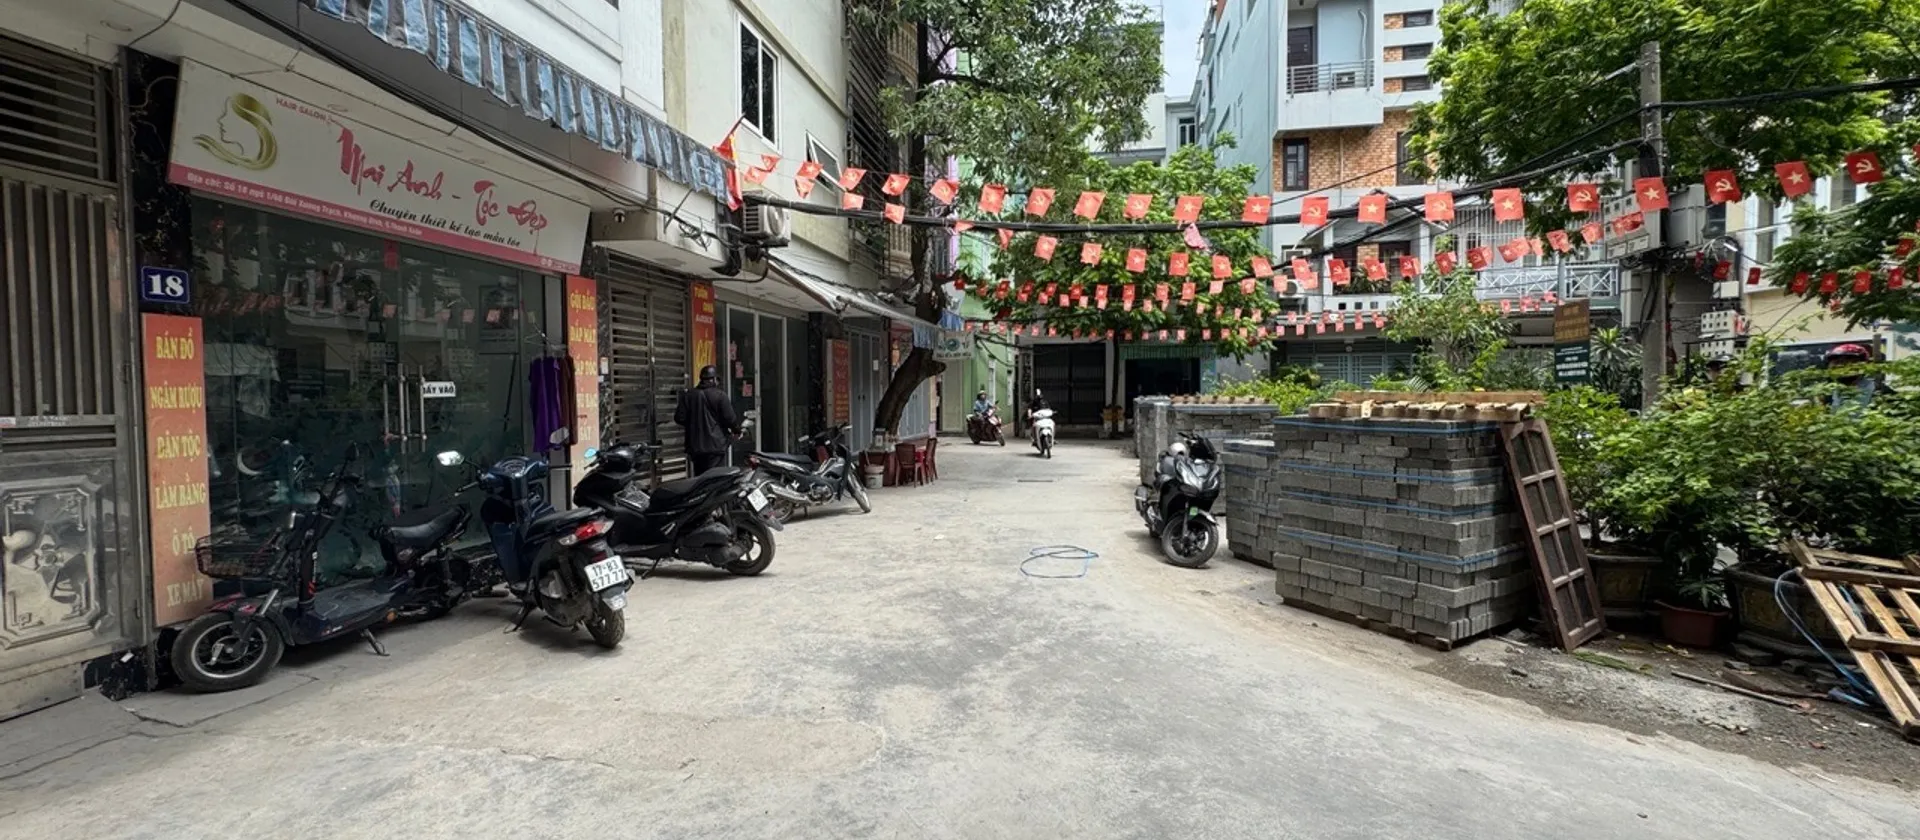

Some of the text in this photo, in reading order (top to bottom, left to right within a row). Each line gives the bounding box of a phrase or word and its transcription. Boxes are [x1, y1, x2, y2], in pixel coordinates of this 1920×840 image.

[276, 96, 327, 121] HAIR SALON
[336, 127, 386, 196] Mai
[147, 273, 185, 298] 18
[156, 331, 179, 360] BÁN
[150, 380, 203, 414] NGÂM RƯỢU
[181, 428, 202, 463] TỘC
[155, 476, 178, 509] LÀM
[167, 574, 205, 608] XE MÁY
[591, 568, 625, 590] 577.77
